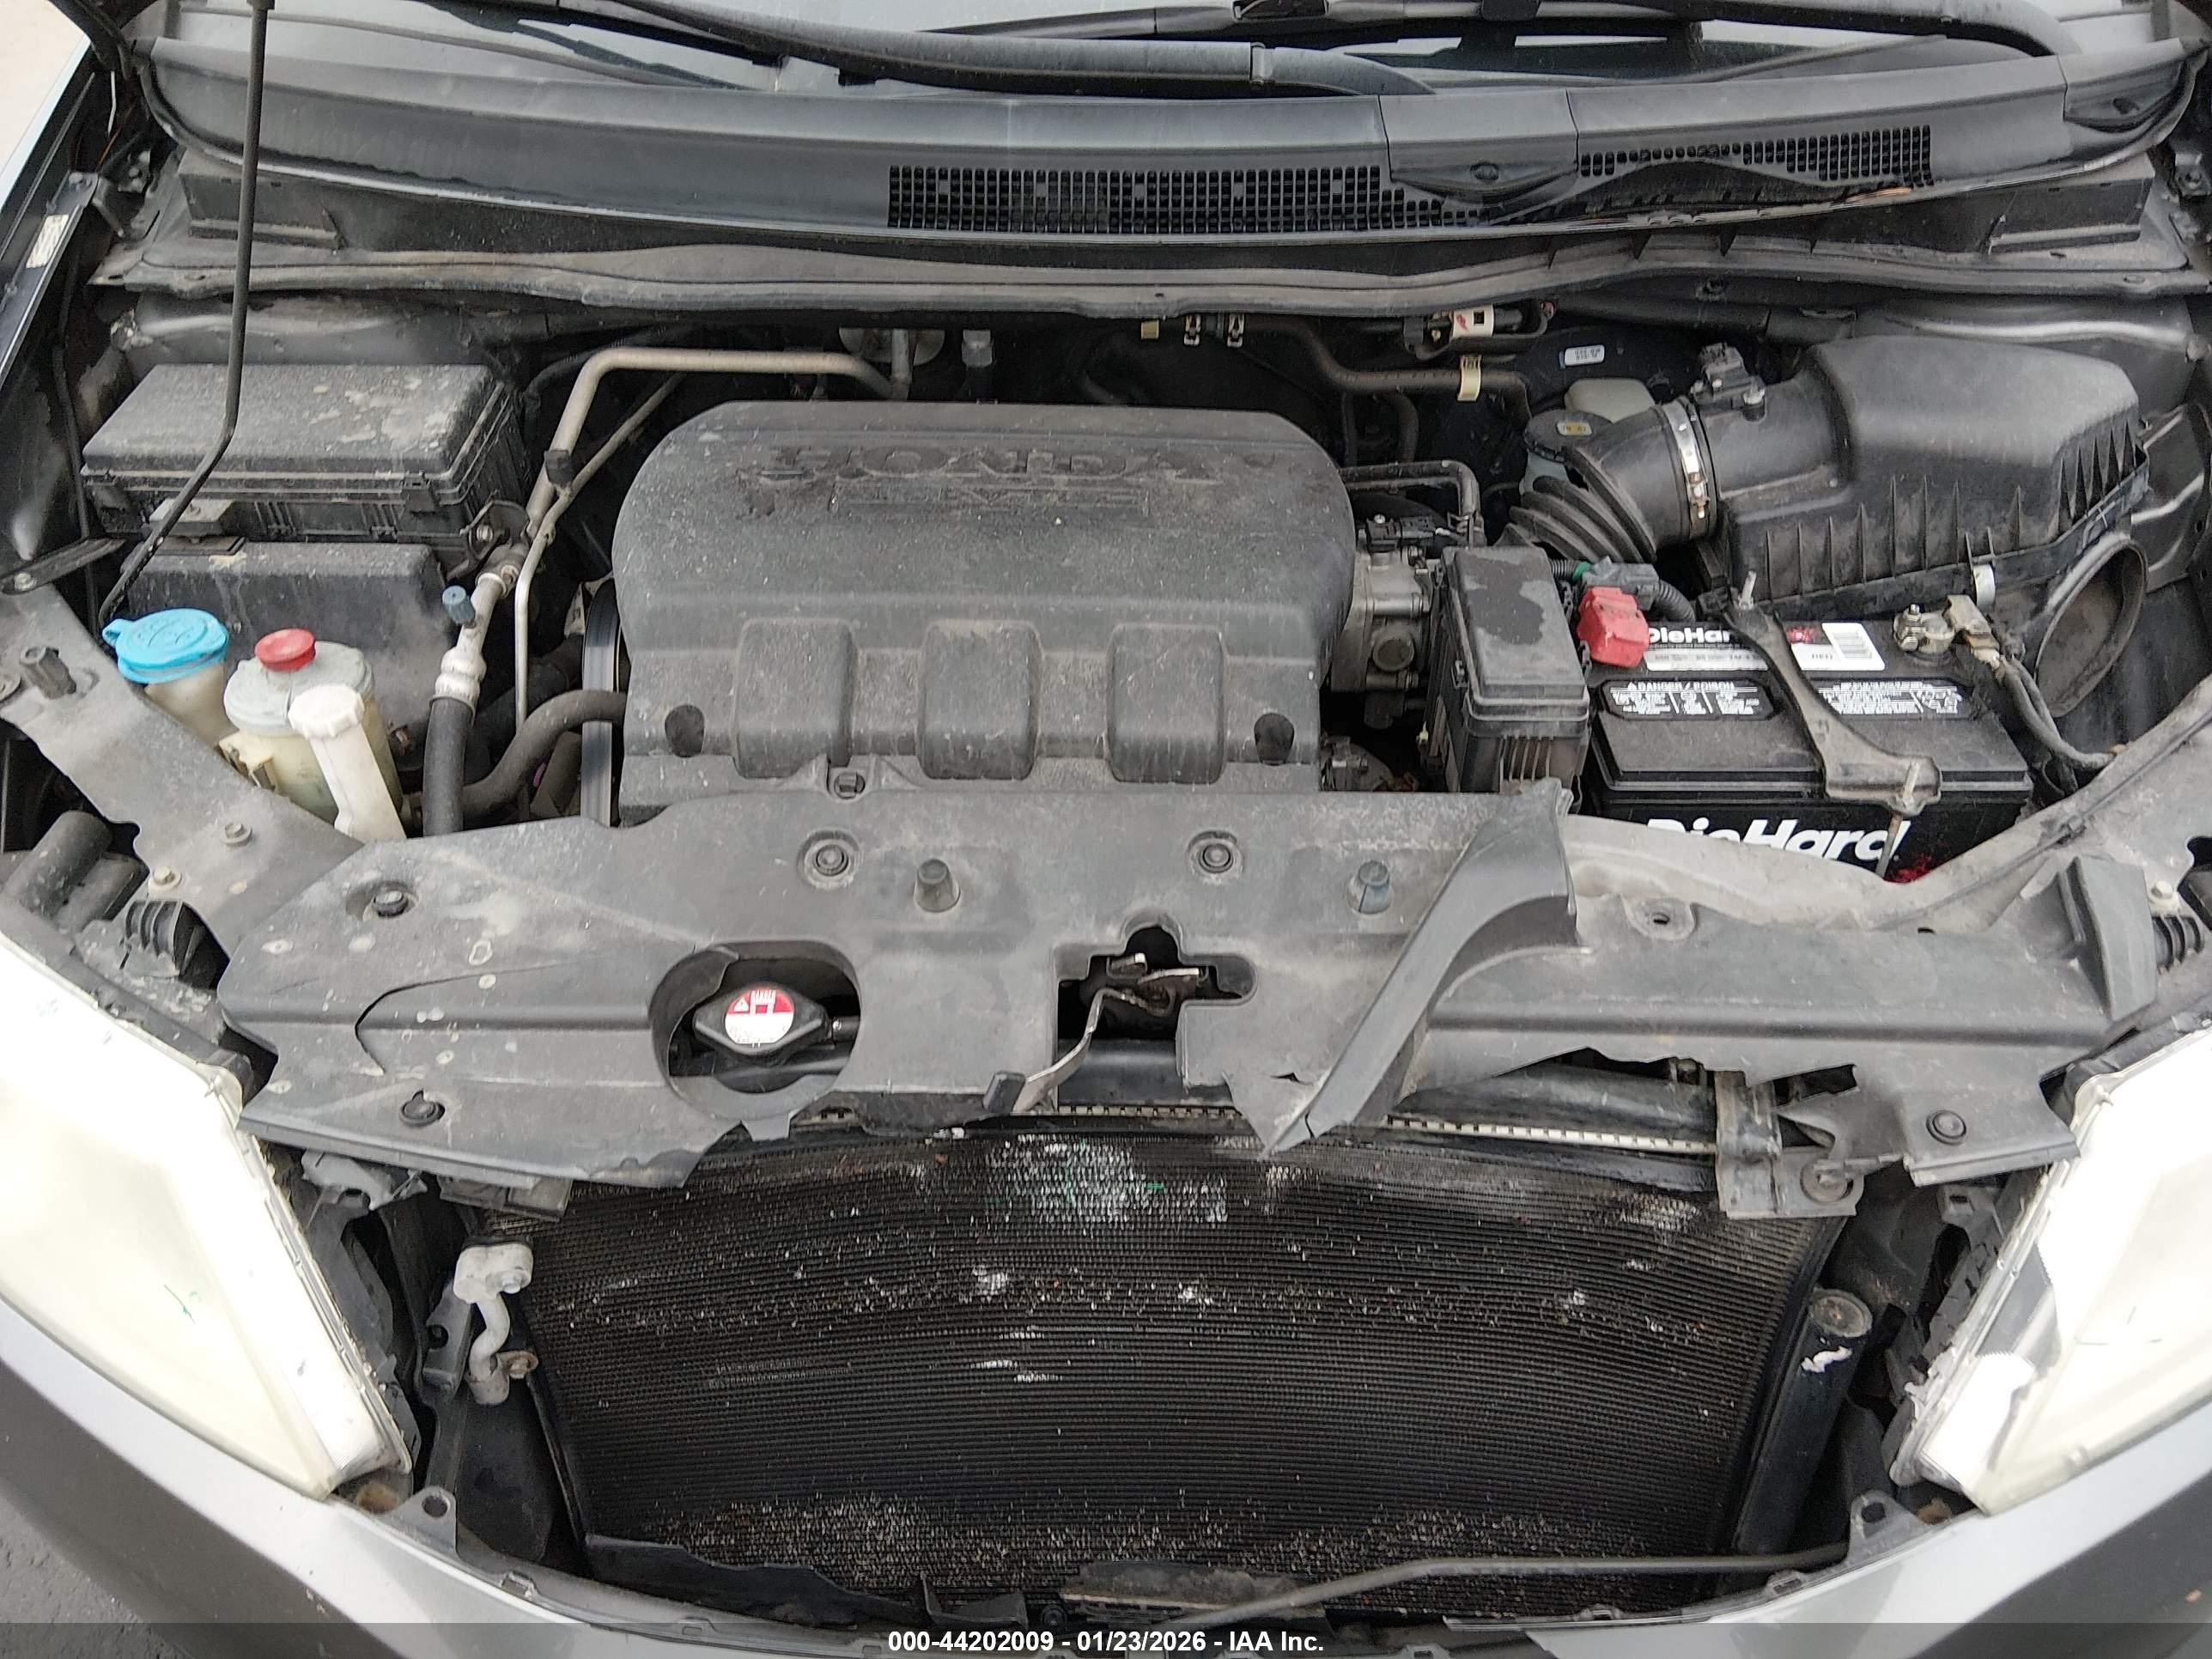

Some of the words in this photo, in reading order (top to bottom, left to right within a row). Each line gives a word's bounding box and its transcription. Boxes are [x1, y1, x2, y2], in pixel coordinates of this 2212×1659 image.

[759, 446, 1223, 485] HONDA
[1648, 627, 1732, 644] DieHar
[1646, 817, 1911, 862] Hard
